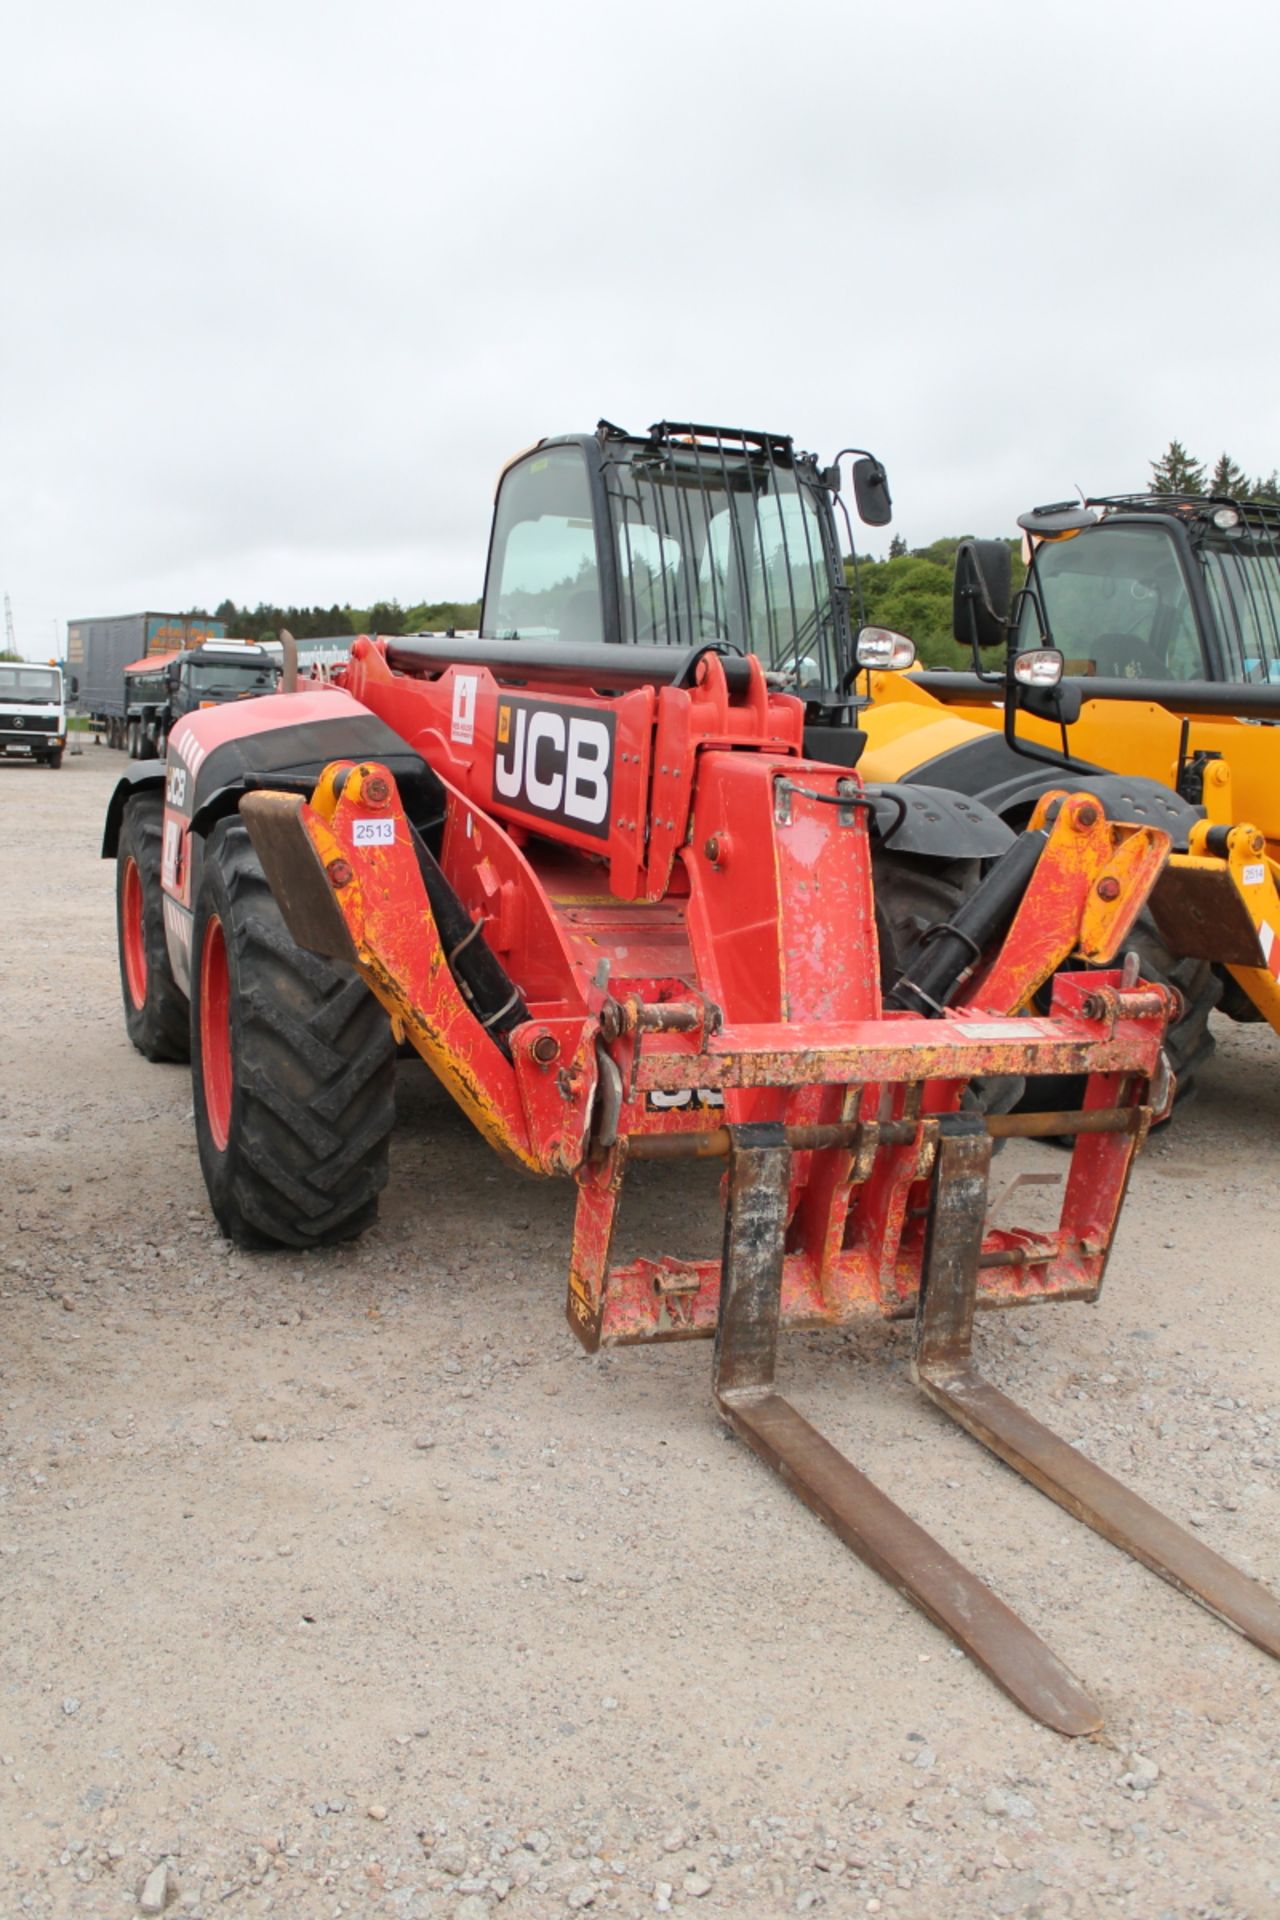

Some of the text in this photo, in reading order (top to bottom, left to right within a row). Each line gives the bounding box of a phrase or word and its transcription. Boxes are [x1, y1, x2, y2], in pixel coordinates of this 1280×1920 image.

[496, 708, 610, 824] JCB
[356, 823, 392, 839] 2513
[1245, 867, 1263, 880] 2514
